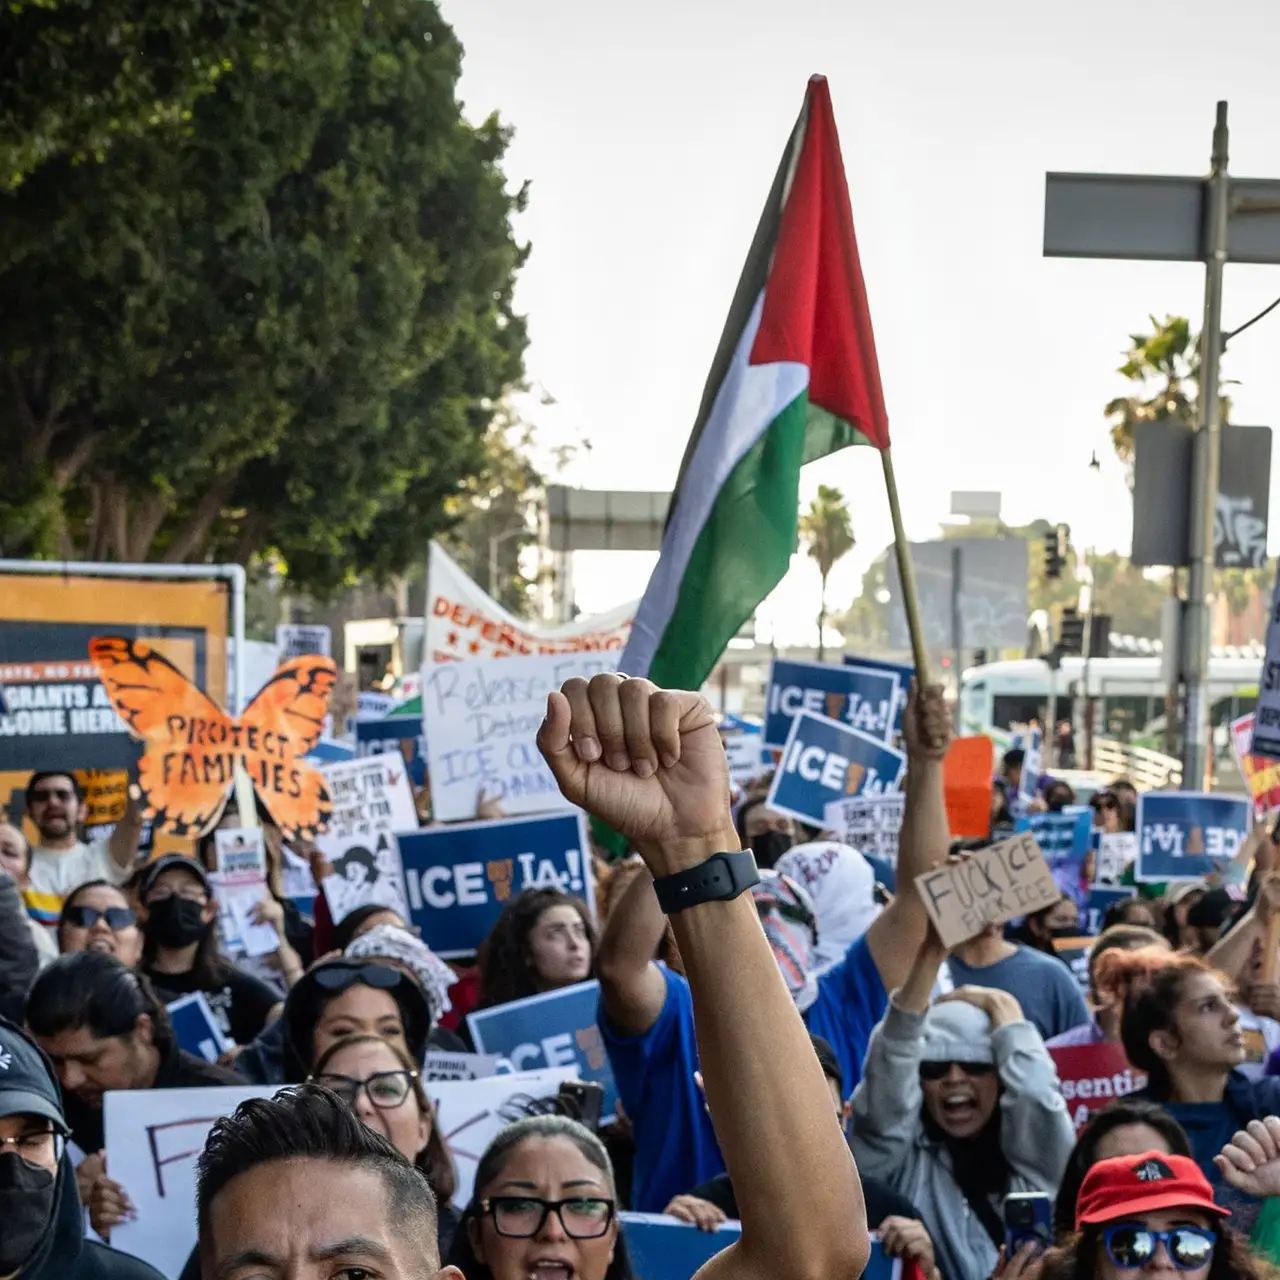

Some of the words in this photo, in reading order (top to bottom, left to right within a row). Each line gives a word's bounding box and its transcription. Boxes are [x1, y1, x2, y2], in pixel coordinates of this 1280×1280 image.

[5, 684, 88, 710] GRANTS
[770, 684, 825, 717] ICE
[166, 714, 289, 760] PROTECT
[162, 752, 302, 799] FAMILIES
[440, 745, 500, 788] ICE
[785, 739, 849, 791] ICE
[406, 861, 488, 911] ICE
[922, 855, 1004, 920] FUCK
[990, 836, 1041, 887] ICE
[1012, 875, 1054, 909] ICE
